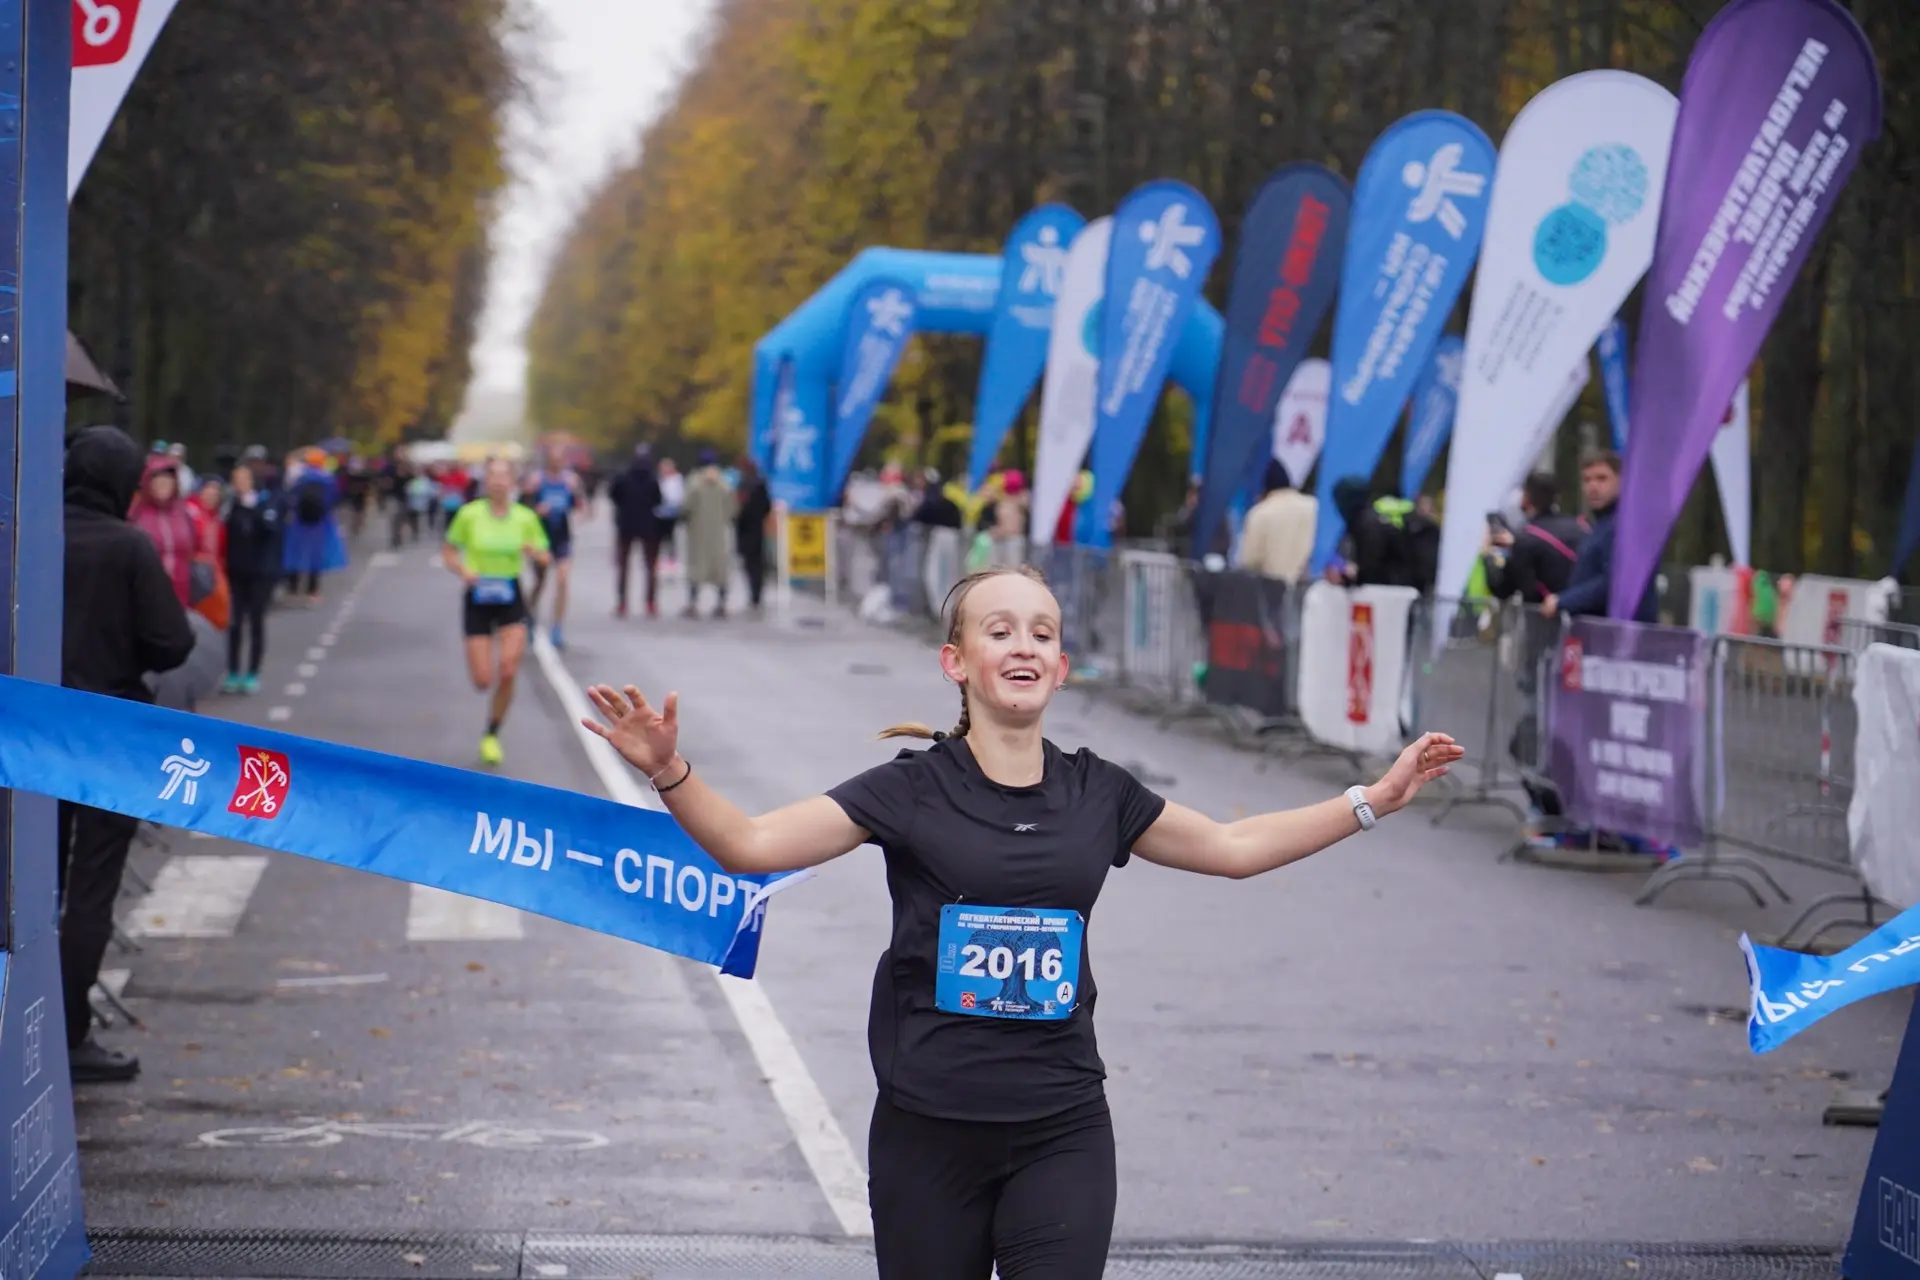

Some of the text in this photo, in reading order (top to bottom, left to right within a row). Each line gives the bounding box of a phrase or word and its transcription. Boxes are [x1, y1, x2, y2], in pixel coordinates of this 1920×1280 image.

[469, 811, 554, 871] МЫ
[959, 944, 1063, 981] 2016
[1755, 980, 1845, 1026] ЫЙ
